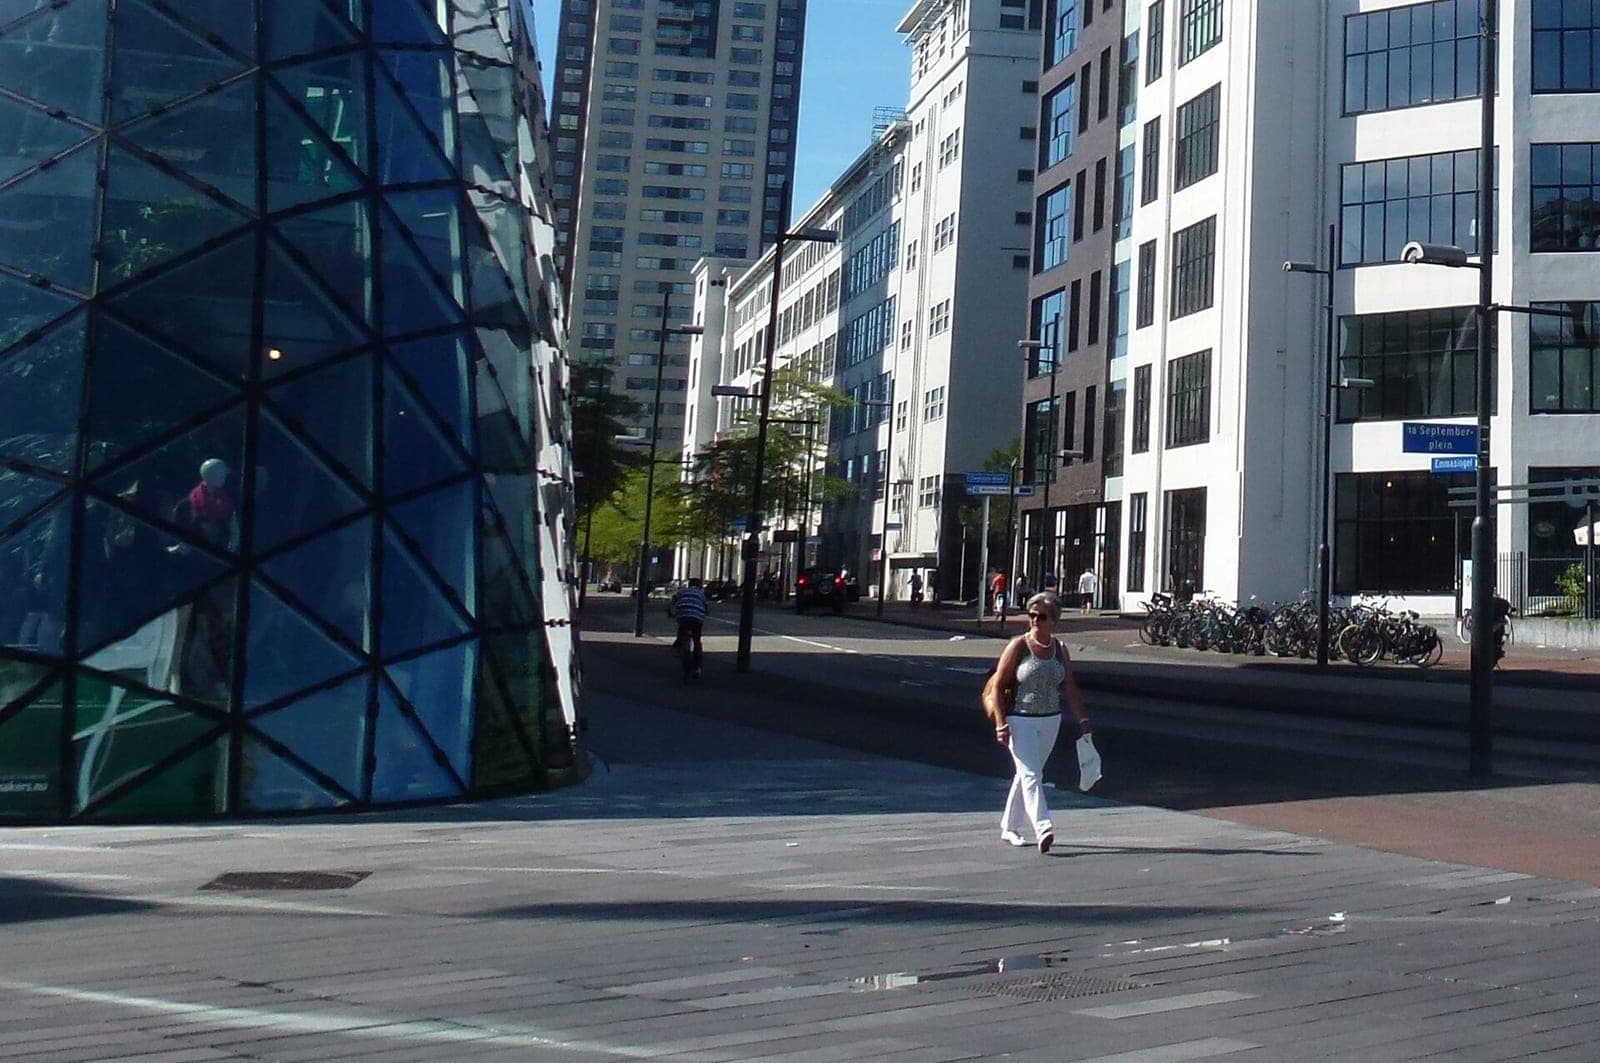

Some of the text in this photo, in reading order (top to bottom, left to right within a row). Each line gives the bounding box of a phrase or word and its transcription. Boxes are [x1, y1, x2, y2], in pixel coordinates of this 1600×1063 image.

[1419, 425, 1474, 437] September-
[1428, 439, 1453, 451] plein
[1434, 458, 1473, 470] Emmasingel
